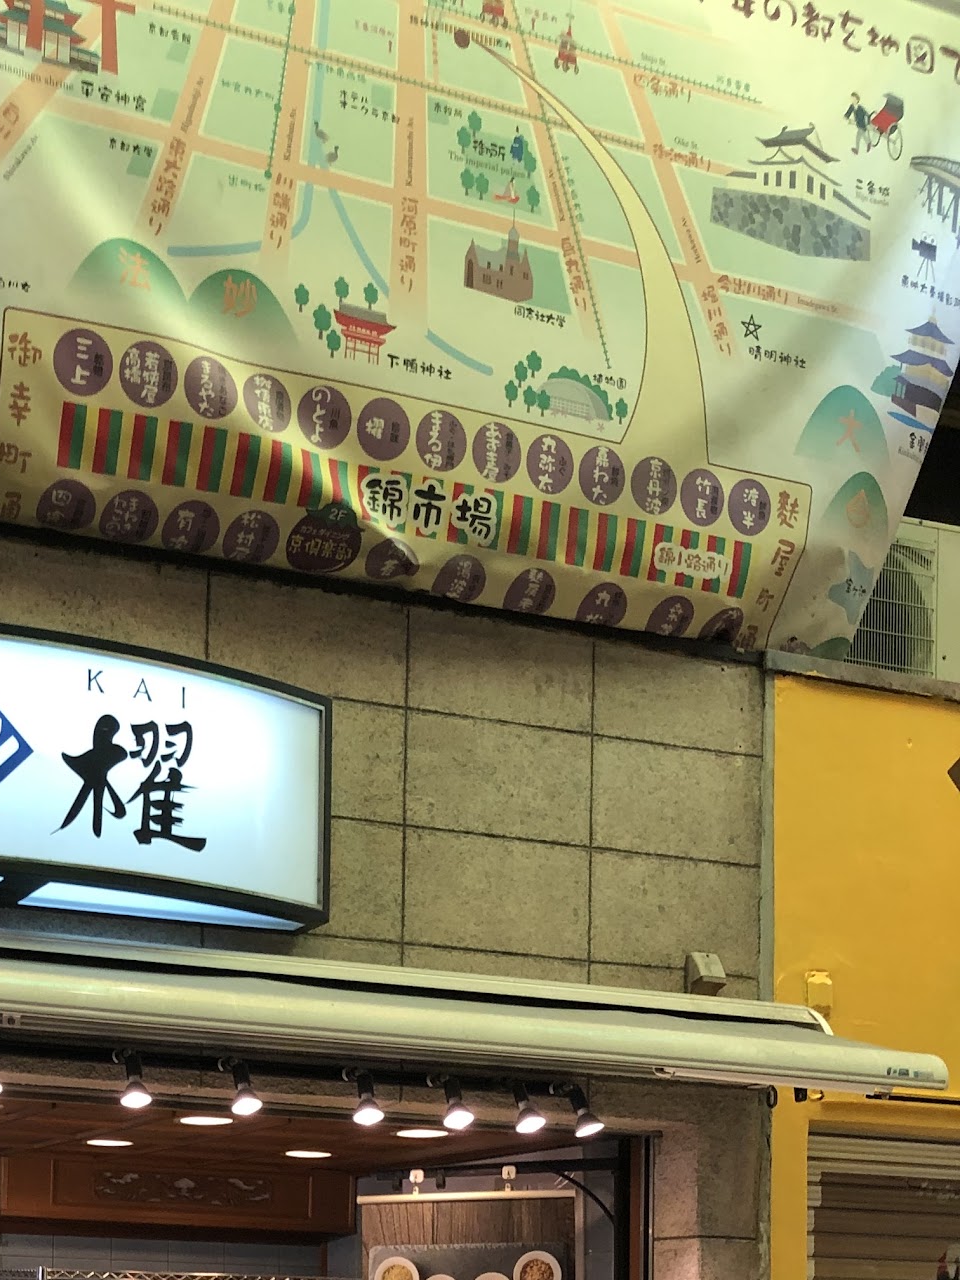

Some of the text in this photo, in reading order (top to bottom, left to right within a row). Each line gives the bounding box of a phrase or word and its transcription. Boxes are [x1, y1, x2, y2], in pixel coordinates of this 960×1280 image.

[81, 79, 147, 112] 平安神宮
[399, 197, 419, 292] 河原町通り
[118, 246, 151, 292] 法
[717, 274, 789, 305] 今出川通り
[221, 274, 258, 319] 妙
[70, 336, 93, 385] 三上
[386, 353, 453, 381] 下鴨神社
[747, 346, 807, 370] 晴明神社
[310, 386, 331, 443] のとよ
[423, 411, 443, 470] まる伊
[538, 435, 557, 492] 丸弥太
[328, 508, 348, 521] 2F
[364, 476, 494, 541] 錦市場
[695, 476, 712, 519] 竹長
[86, 669, 186, 710] KAI
[51, 713, 207, 853] 櫂
